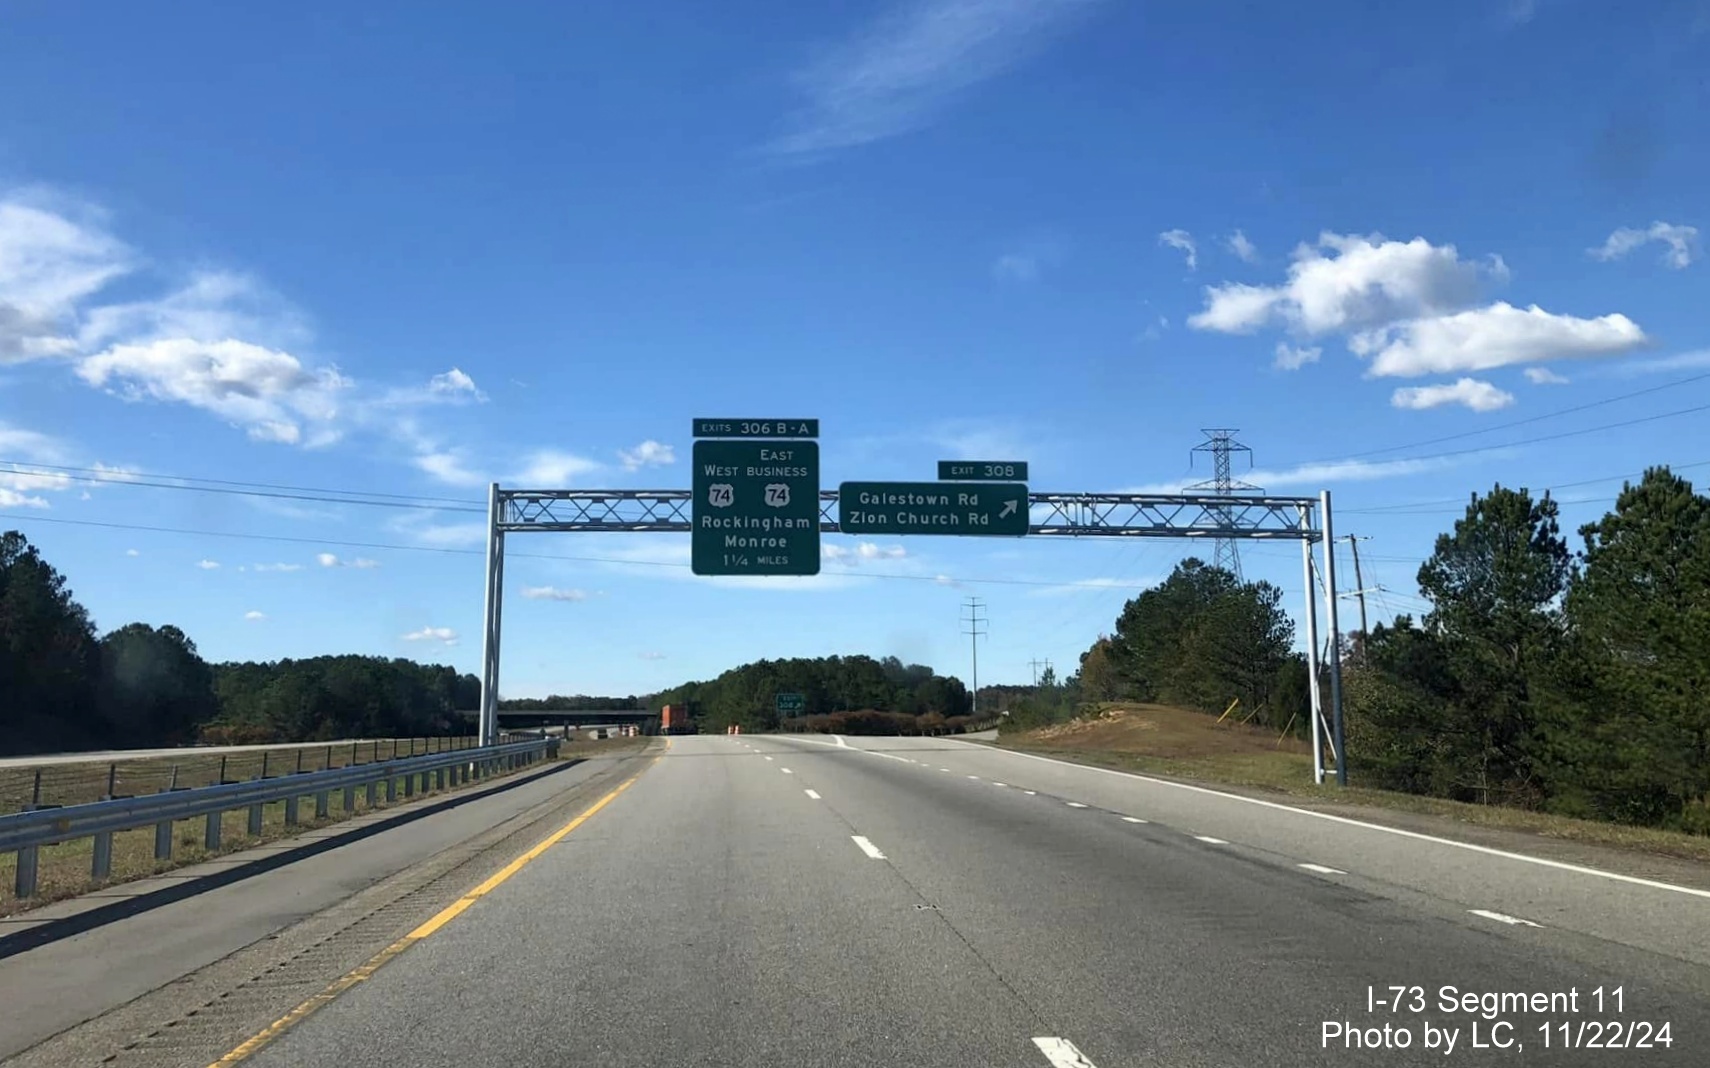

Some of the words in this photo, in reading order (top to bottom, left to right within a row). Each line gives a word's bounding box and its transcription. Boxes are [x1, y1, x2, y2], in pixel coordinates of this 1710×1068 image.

[702, 424, 731, 433] EXITS
[740, 423, 771, 434] 306
[746, 466, 808, 476] BUSINESS
[951, 466, 974, 475] EXIT
[984, 466, 1014, 476] 308
[713, 489, 730, 502] 74
[769, 489, 786, 502] 74
[859, 492, 949, 505] Galestown
[958, 493, 978, 505] Rd
[702, 516, 810, 531] Rockingham
[850, 512, 887, 524] Zion
[897, 512, 959, 524] Church
[969, 513, 989, 525] Rd
[725, 535, 787, 547] Monroe
[757, 556, 788, 564] MILES
